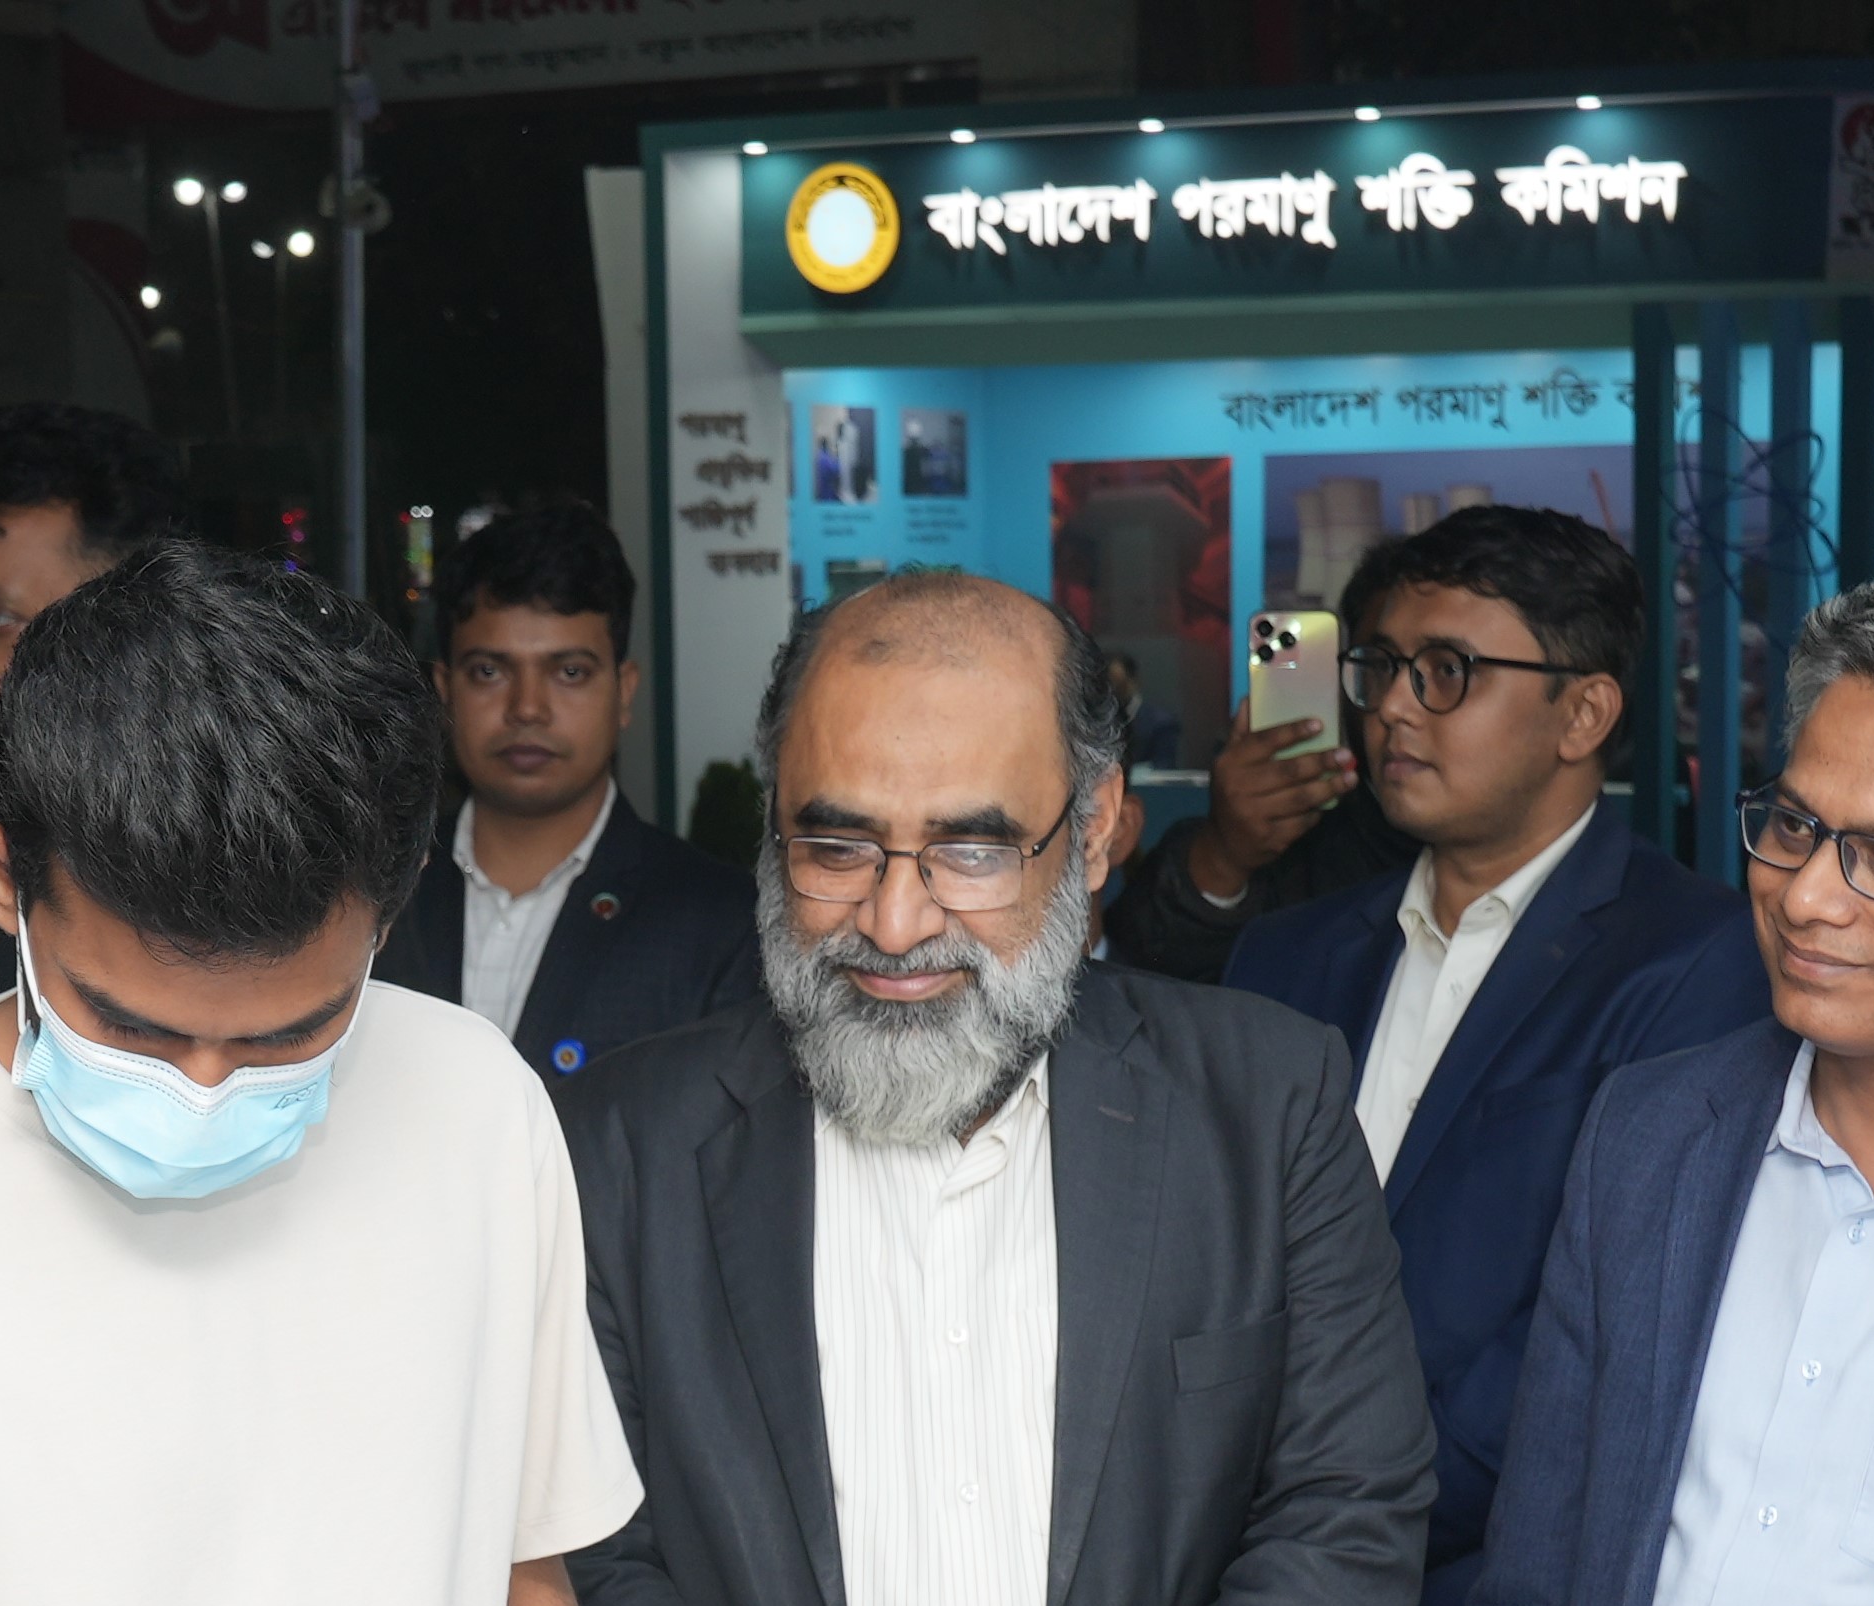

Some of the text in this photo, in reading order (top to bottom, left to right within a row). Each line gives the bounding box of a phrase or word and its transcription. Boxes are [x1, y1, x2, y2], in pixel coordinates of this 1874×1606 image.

[925, 178, 1156, 255] বাংলাদেশ
[1172, 170, 1337, 249] পরমাণু
[1355, 152, 1475, 232] শক্তি
[1495, 146, 1687, 224] কমিশন
[1221, 384, 1382, 433] বাংলাদেশ
[1396, 377, 1511, 433] পরমাণু
[1520, 365, 1602, 423] শক্তি
